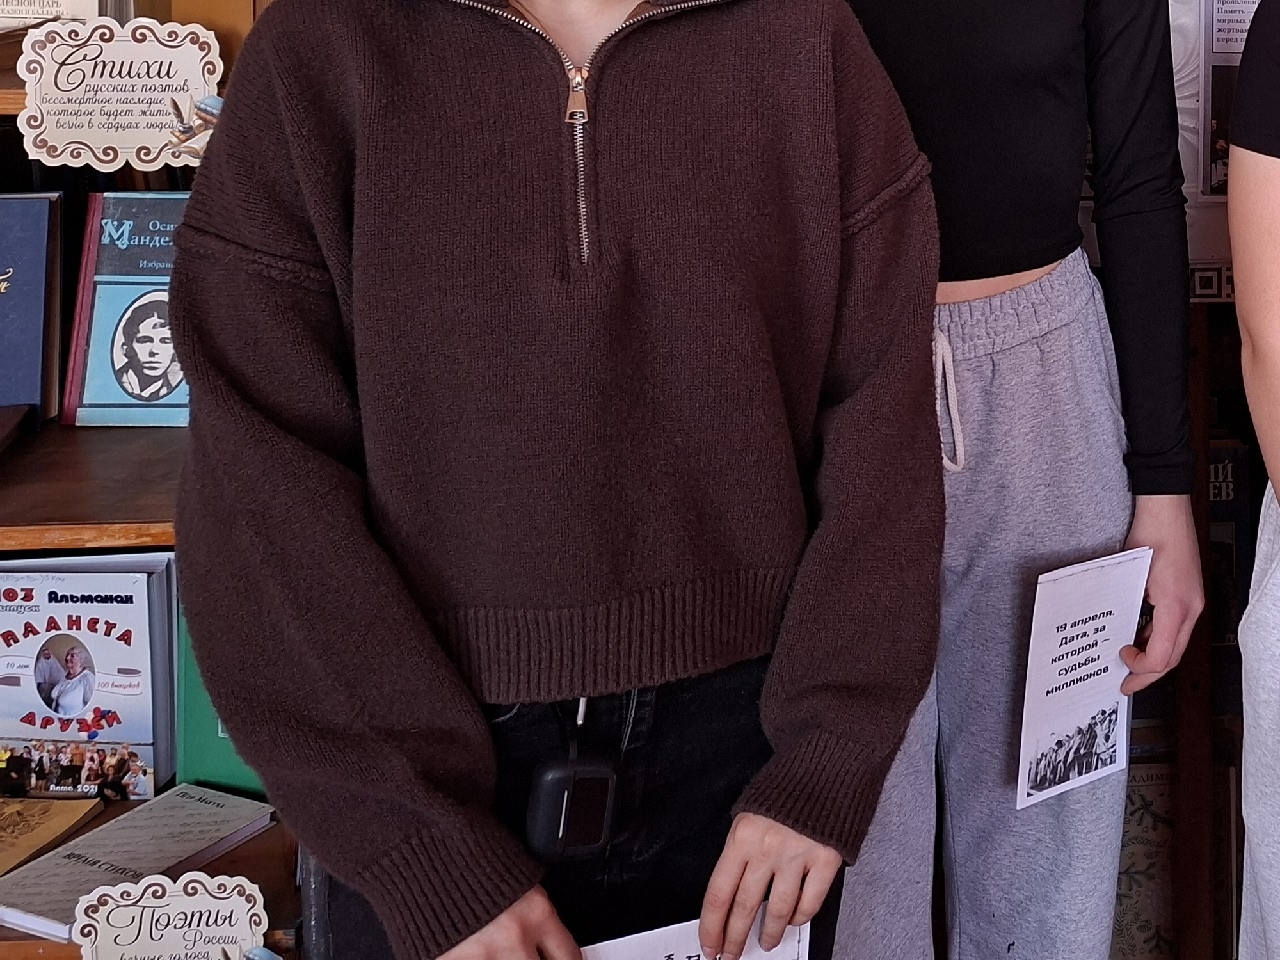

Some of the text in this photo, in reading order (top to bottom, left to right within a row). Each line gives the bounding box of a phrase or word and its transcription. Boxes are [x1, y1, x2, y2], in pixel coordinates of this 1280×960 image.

[51, 44, 177, 92] Стихи
[83, 79, 190, 96] русских поэтов
[41, 93, 167, 109] бессмертное наследие,
[47, 109, 96, 120] которое
[100, 106, 134, 120] будет
[56, 120, 140, 133] вечно в сердцах
[0, 615, 133, 648] ПЛАНЕТА
[1056, 609, 1115, 634] 19 апреля.
[1059, 624, 1106, 648] Дата, за
[1051, 639, 1098, 665] которой
[1058, 654, 1101, 677] судьбы
[1046, 665, 1109, 697] миллионов
[106, 902, 238, 946] Поэты
[182, 928, 239, 950] России
